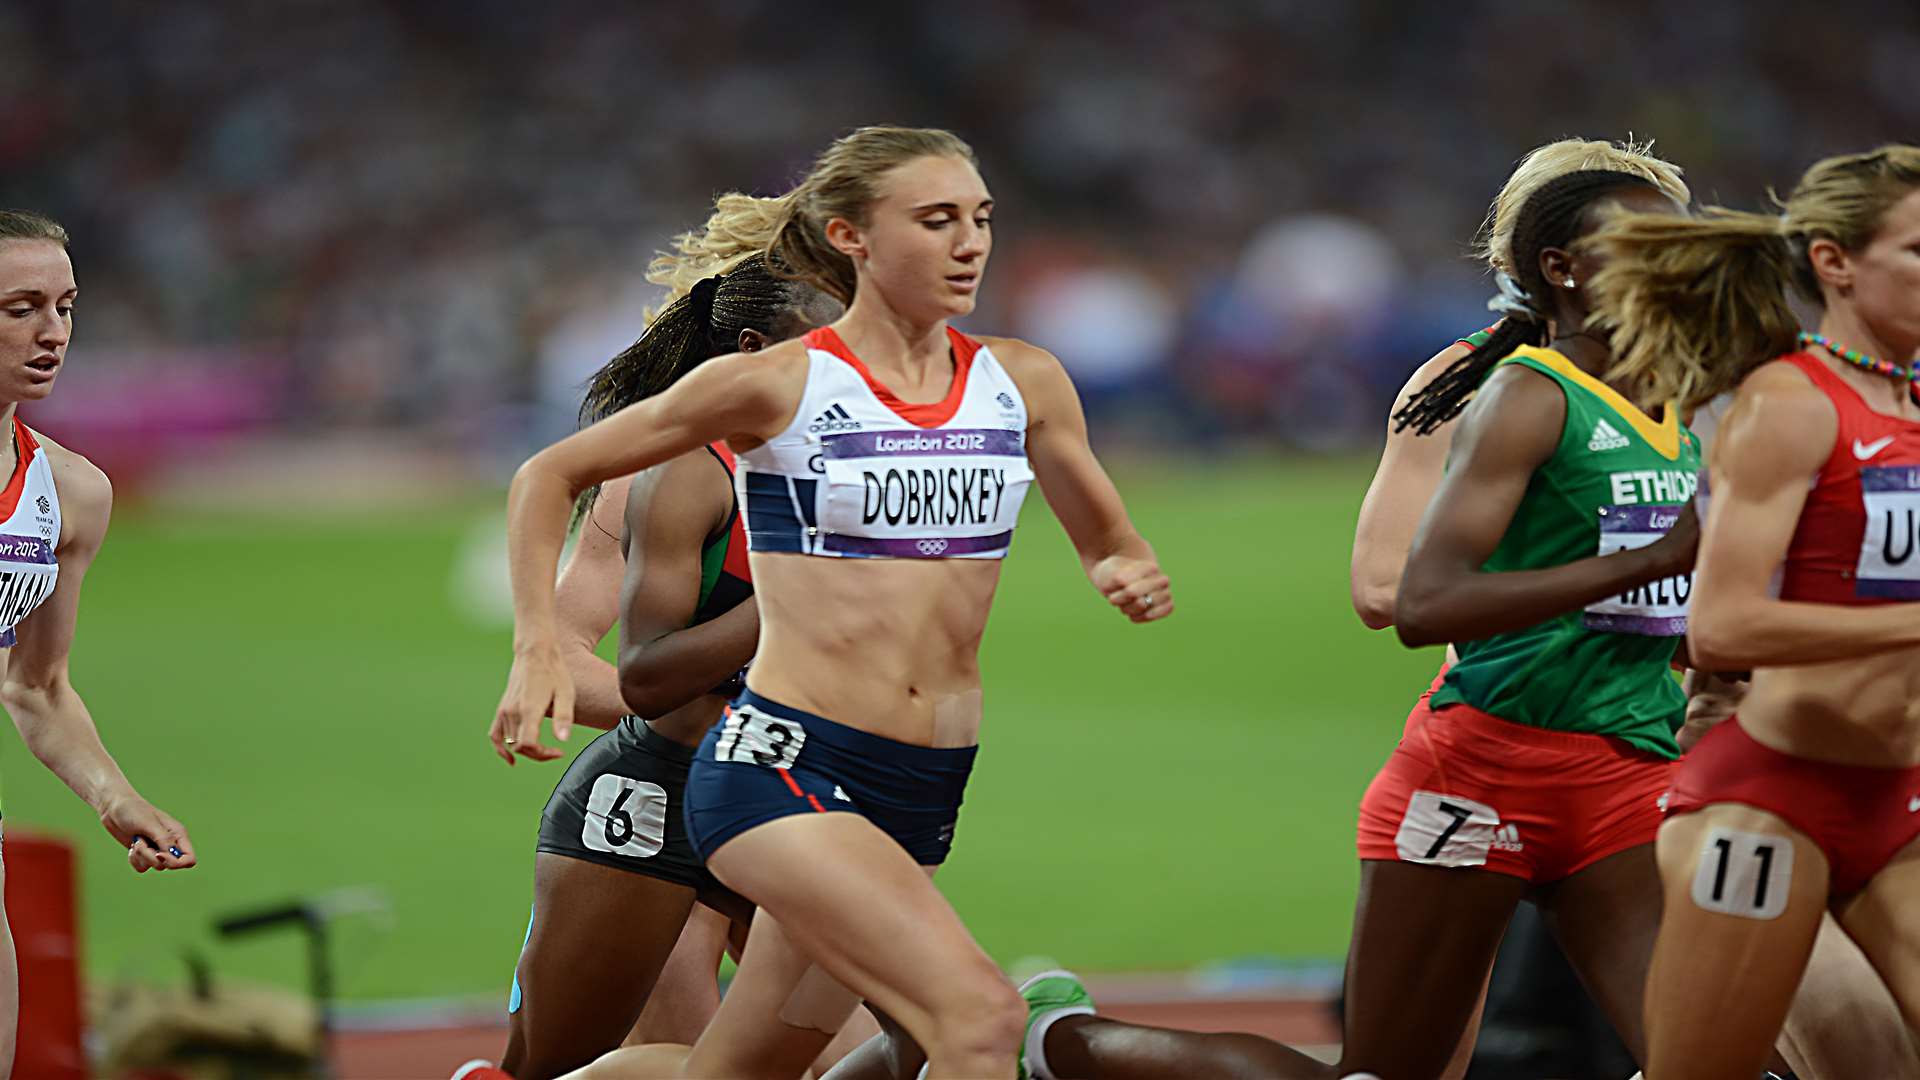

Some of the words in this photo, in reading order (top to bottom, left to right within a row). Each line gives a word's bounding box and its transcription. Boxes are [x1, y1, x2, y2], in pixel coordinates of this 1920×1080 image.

[809, 421, 861, 433] adidas
[875, 434, 942, 451] London
[944, 433, 985, 449] 2012
[863, 467, 1005, 526] DOBRISKEY
[14, 541, 40, 558] 2012
[1883, 509, 1920, 566] U
[0, 572, 50, 627] TMAN
[727, 713, 794, 765] 13
[604, 787, 634, 847] 6
[1424, 801, 1473, 858] 7
[1711, 837, 1775, 908] 11
